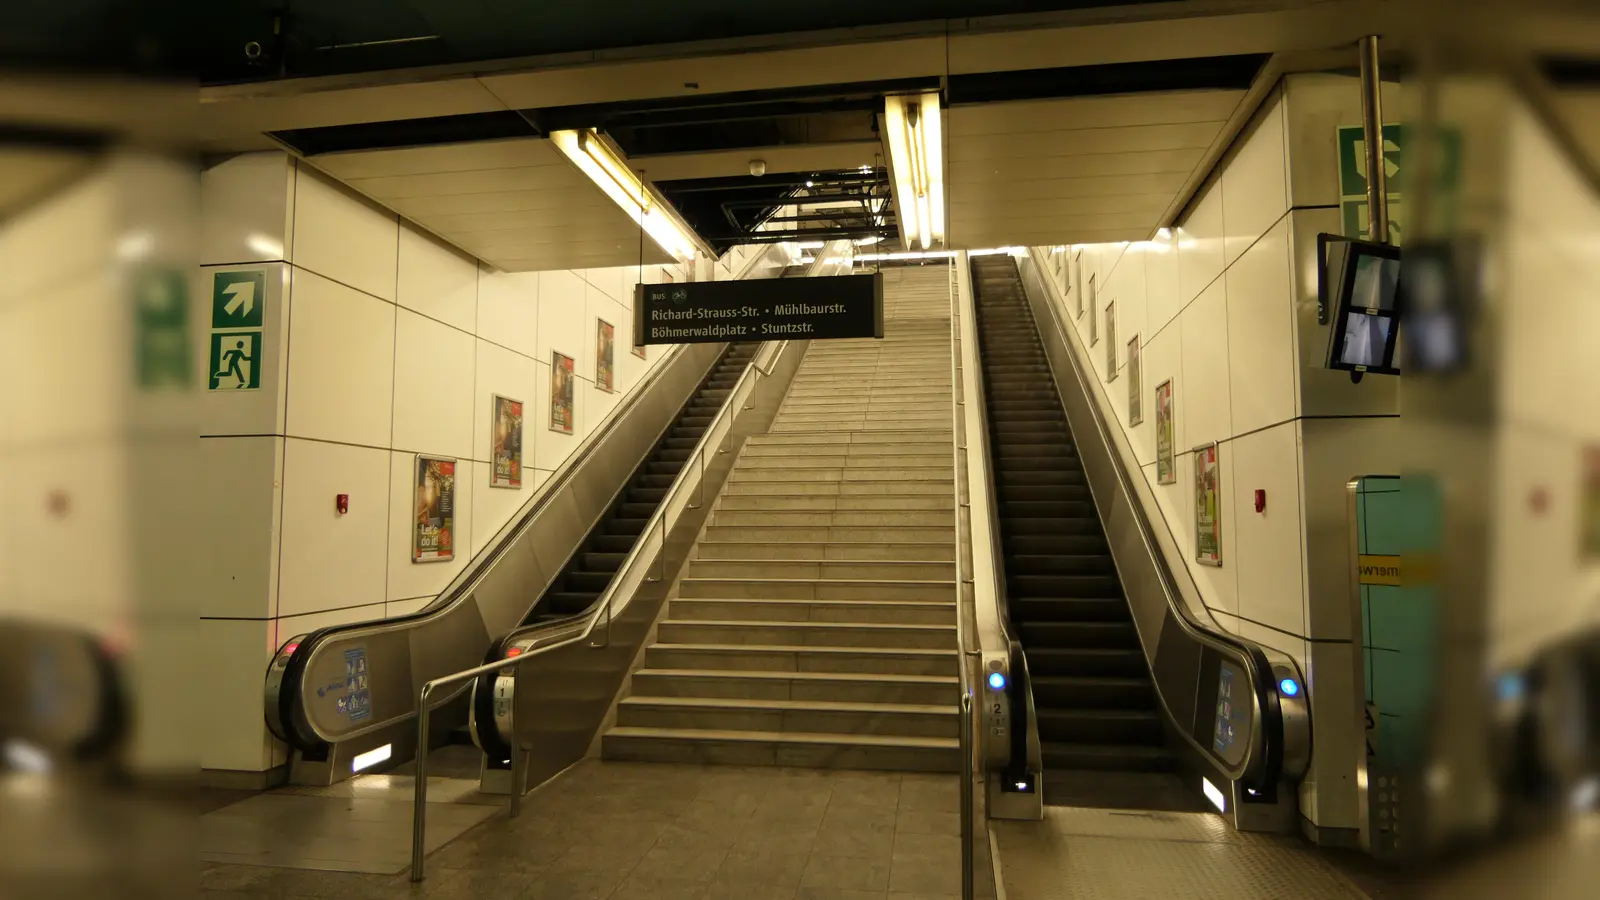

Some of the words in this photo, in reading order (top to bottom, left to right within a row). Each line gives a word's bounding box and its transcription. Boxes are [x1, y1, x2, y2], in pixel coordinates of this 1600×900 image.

[652, 292, 666, 300] BUS
[651, 307, 760, 321] Richard-Strauss-Str.
[774, 303, 847, 316] Mühlbaurstr.
[651, 325, 747, 338] Böhmerwaldplatz
[761, 322, 814, 334] Stuntzstr.
[421, 524, 438, 535] Let's
[421, 535, 430, 546] do
[500, 688, 505, 697] 1
[993, 703, 1002, 714] 2
